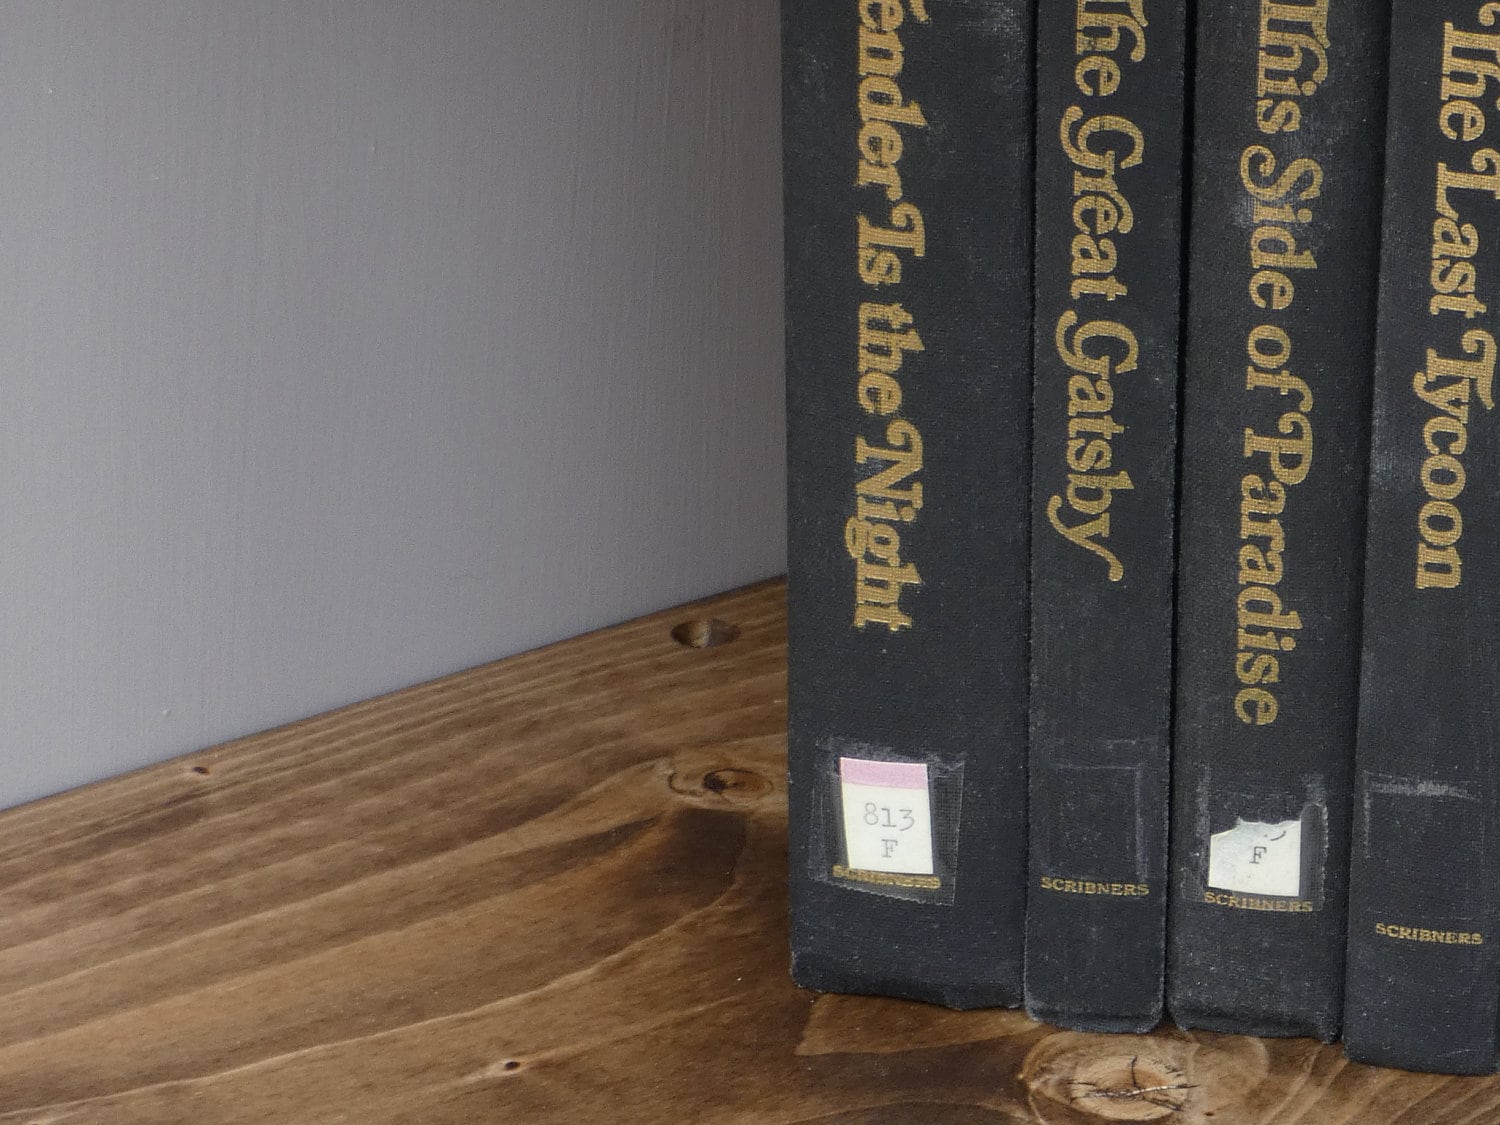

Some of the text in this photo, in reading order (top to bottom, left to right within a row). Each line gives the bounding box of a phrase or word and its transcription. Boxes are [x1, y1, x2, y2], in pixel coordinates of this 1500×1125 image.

[1060, 105, 1145, 301] Great
[1239, 145, 1324, 310] Side
[845, 0, 931, 632] ender Is the Night
[1246, 324, 1313, 412] of
[1047, 310, 1140, 582] Gatsby
[1412, 329, 1496, 590] Tycoon
[1234, 411, 1313, 726] Paradise
[863, 802, 915, 832] 813
[881, 838, 898, 858] F
[1249, 845, 1267, 864] F
[1041, 876, 1150, 896] SCRIBNERS
[1376, 922, 1482, 945] SCRIBNERS
